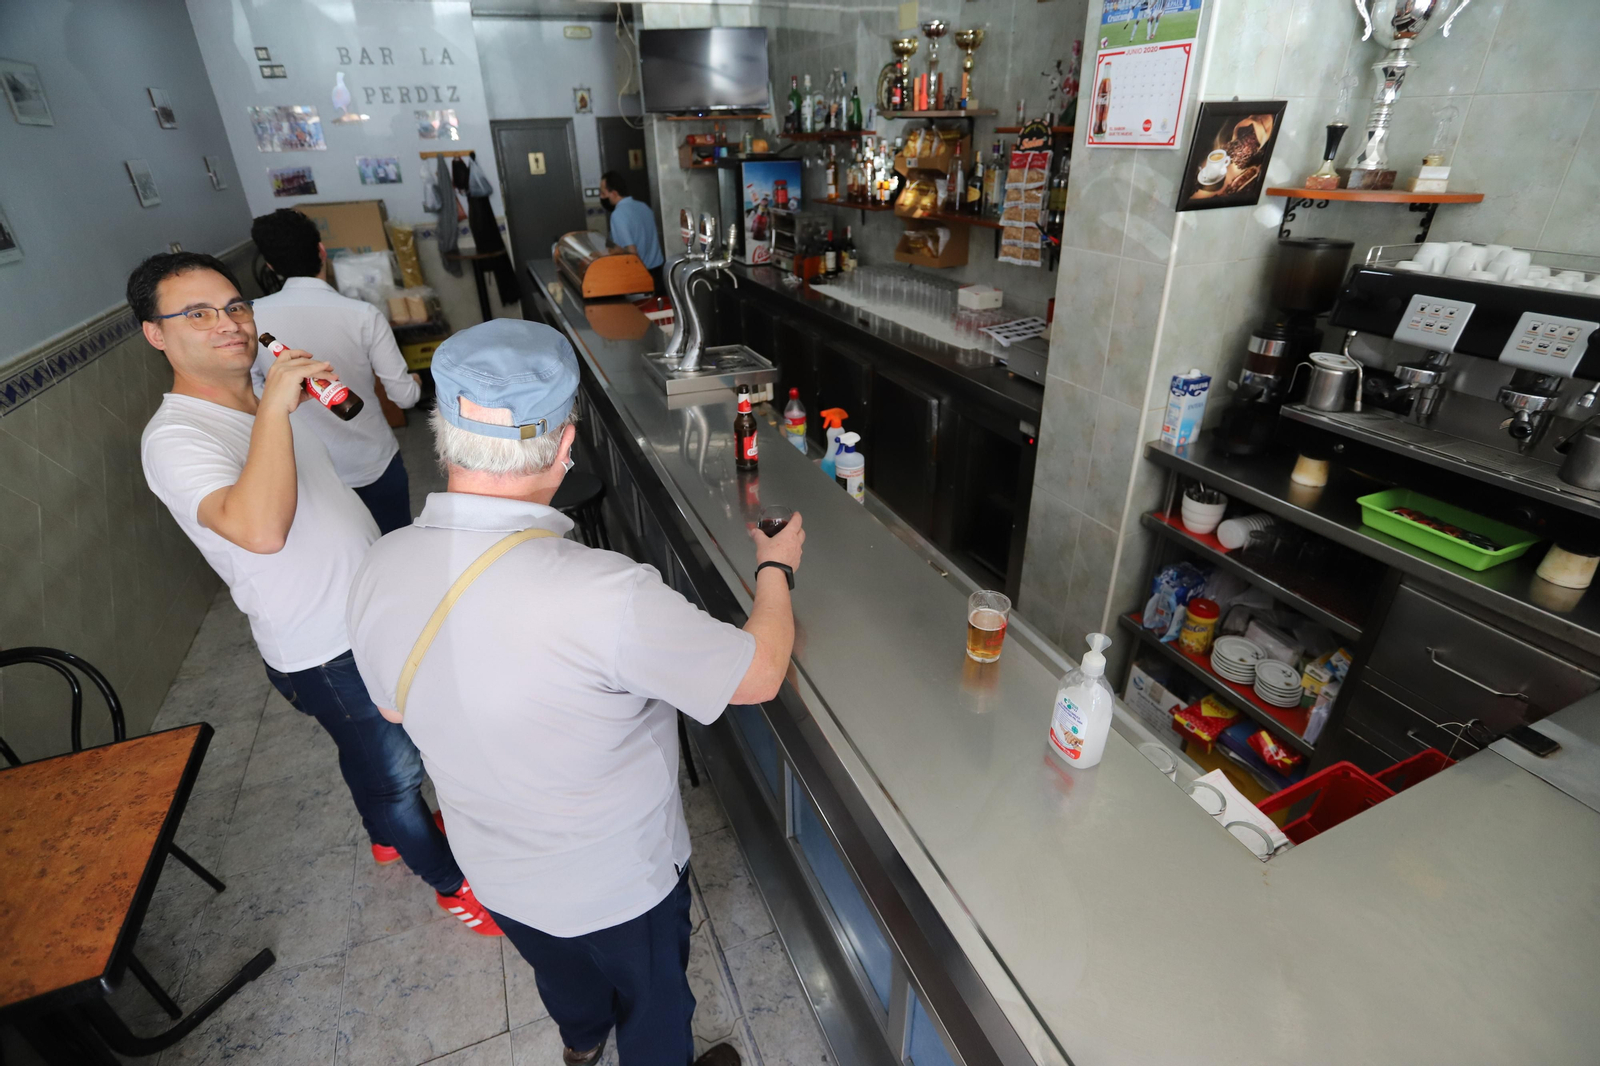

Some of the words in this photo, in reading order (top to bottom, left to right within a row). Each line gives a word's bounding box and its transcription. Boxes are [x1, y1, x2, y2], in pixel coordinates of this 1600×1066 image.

[336, 47, 394, 66] BAR
[419, 47, 455, 66] LA
[1125, 48, 1143, 56] JUNIO
[1143, 46, 1158, 54] 2020
[362, 85, 460, 105] PERDIZ
